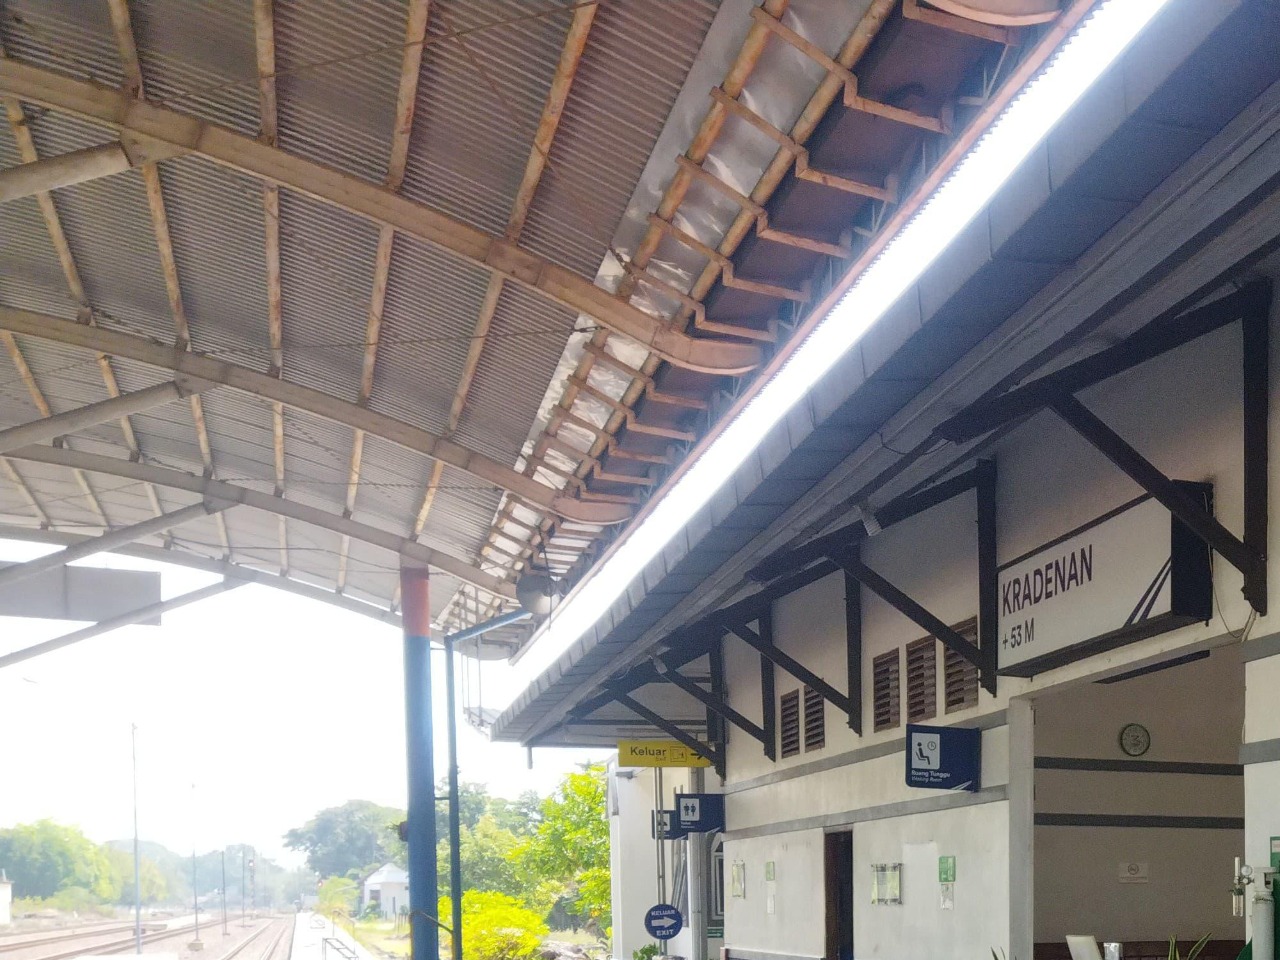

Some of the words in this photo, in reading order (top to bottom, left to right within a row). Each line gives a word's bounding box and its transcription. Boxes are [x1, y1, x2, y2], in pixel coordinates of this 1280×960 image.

[1002, 544, 1093, 617] KRADENAN
[1010, 624, 1022, 649] 53
[1024, 617, 1035, 644] M
[630, 746, 667, 756] Keluar
